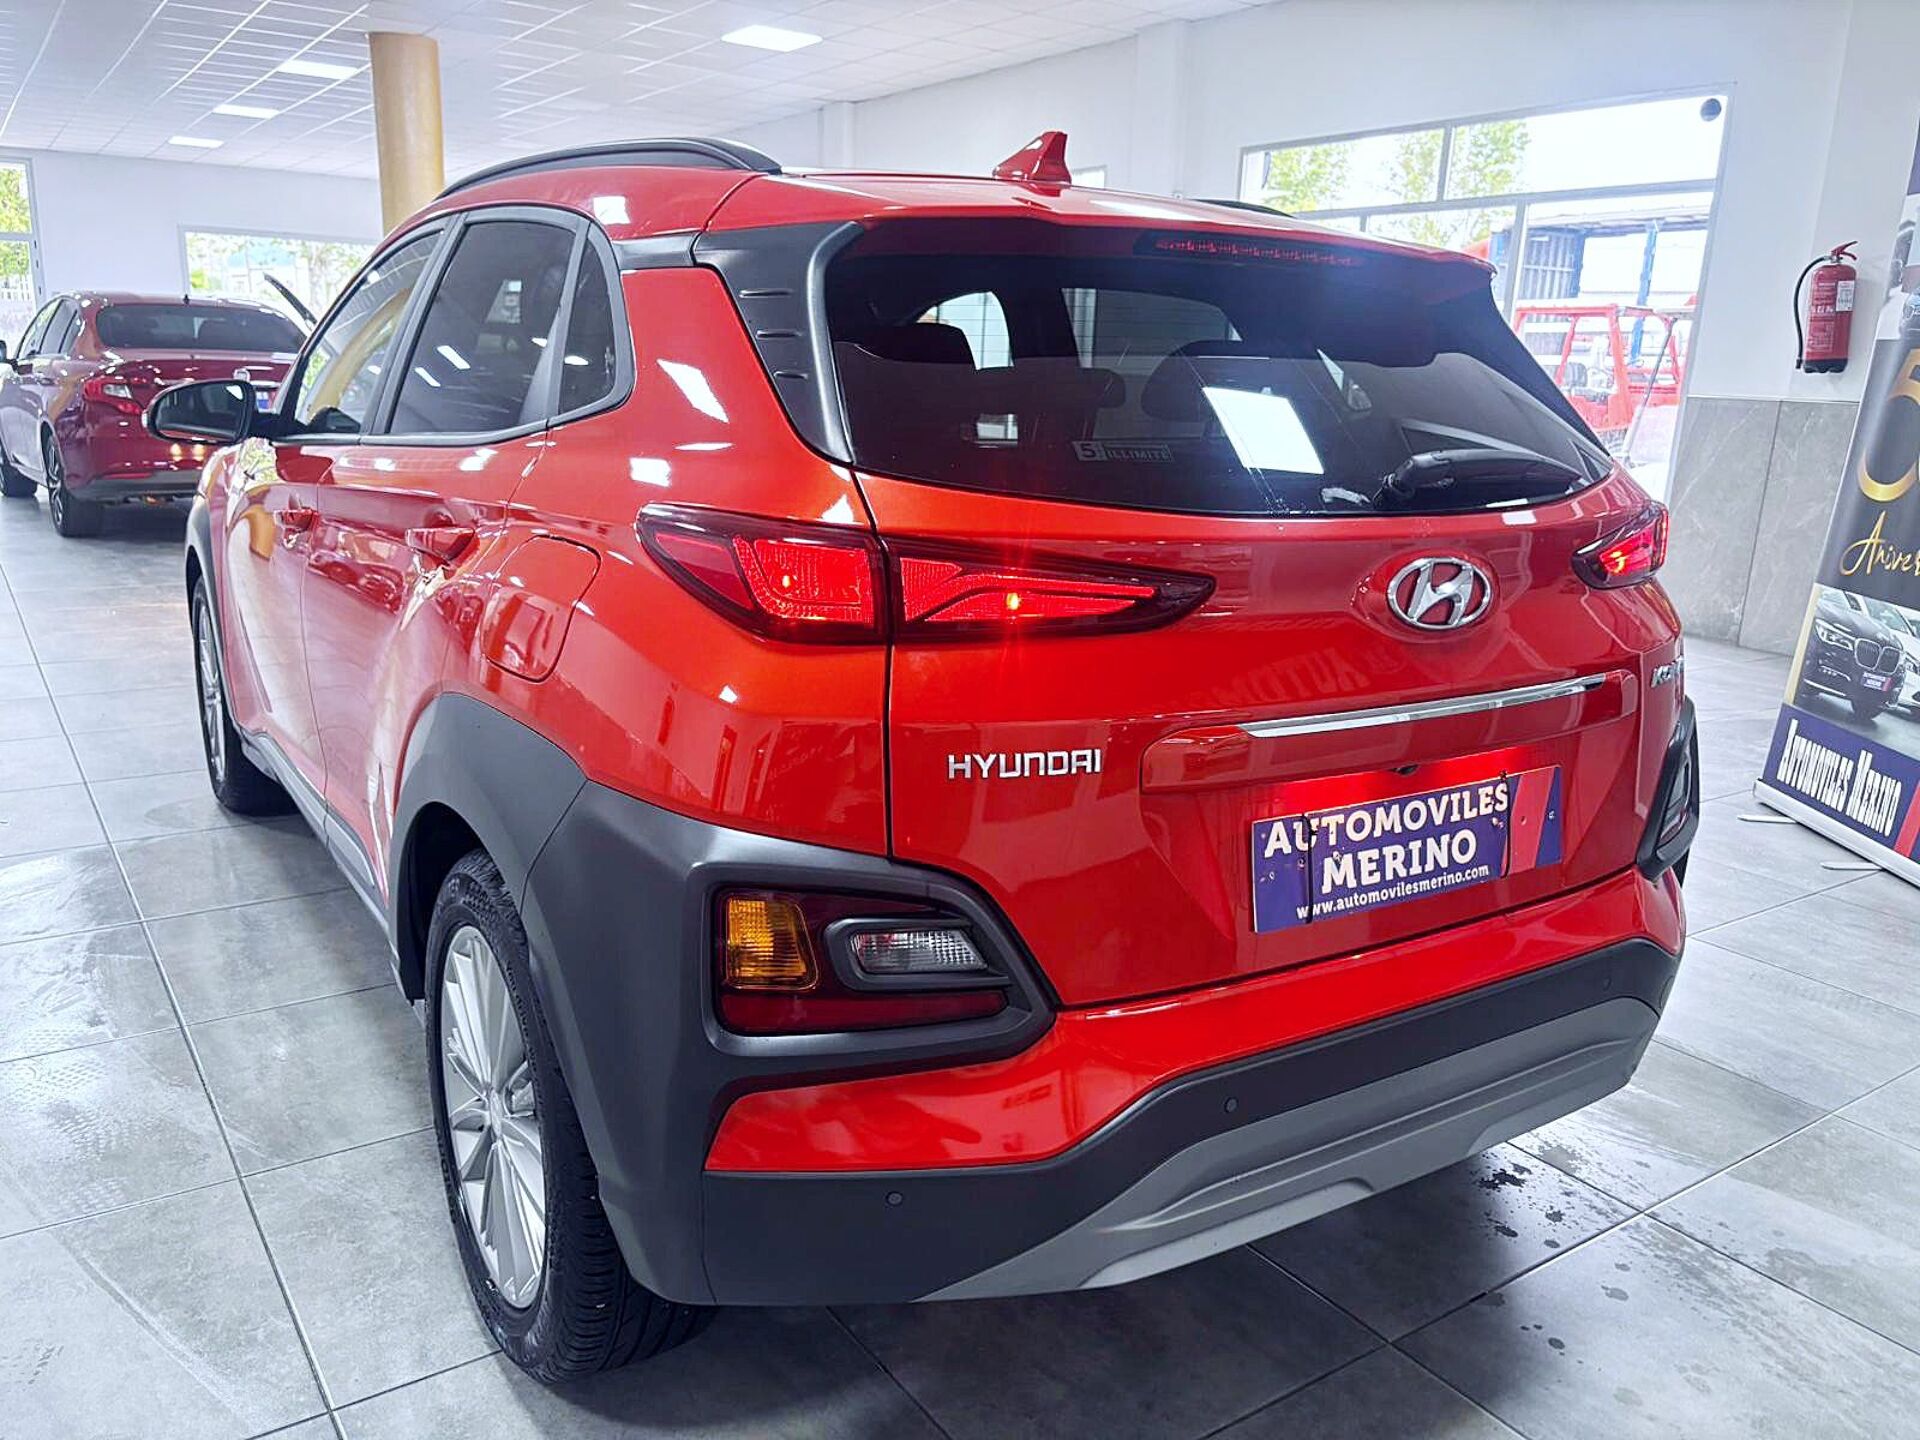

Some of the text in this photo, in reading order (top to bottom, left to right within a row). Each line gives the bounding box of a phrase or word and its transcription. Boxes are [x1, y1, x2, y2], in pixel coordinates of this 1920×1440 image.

[948, 748, 1101, 779] HYUNDAI
[1264, 782, 1509, 859] AUTOMOVILES
[1296, 863, 1490, 920] www.automovilesmerino.com
[1321, 828, 1478, 895] MERINO
